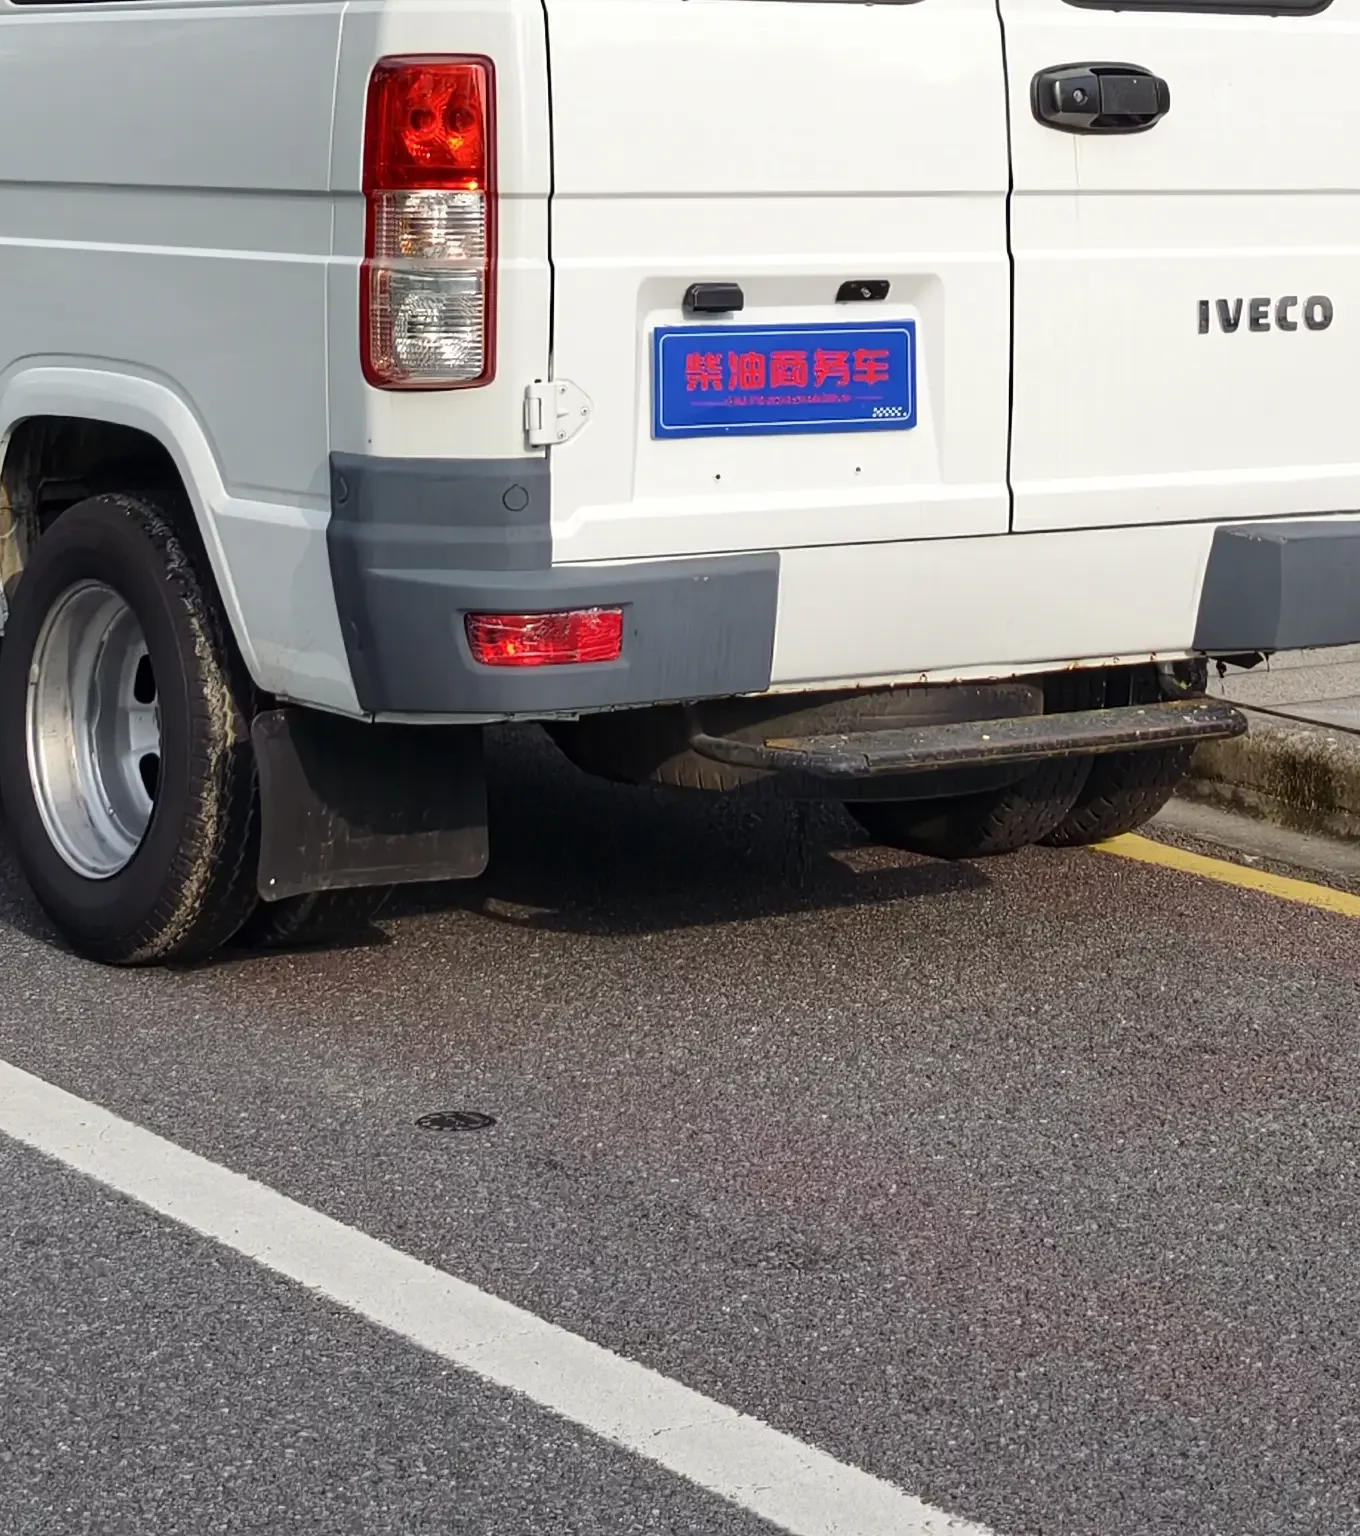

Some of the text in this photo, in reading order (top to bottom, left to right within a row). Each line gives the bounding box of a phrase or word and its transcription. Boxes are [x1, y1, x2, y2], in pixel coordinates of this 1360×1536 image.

[1197, 295, 1334, 334] IVECO
[685, 348, 890, 391] 柴油商务车
